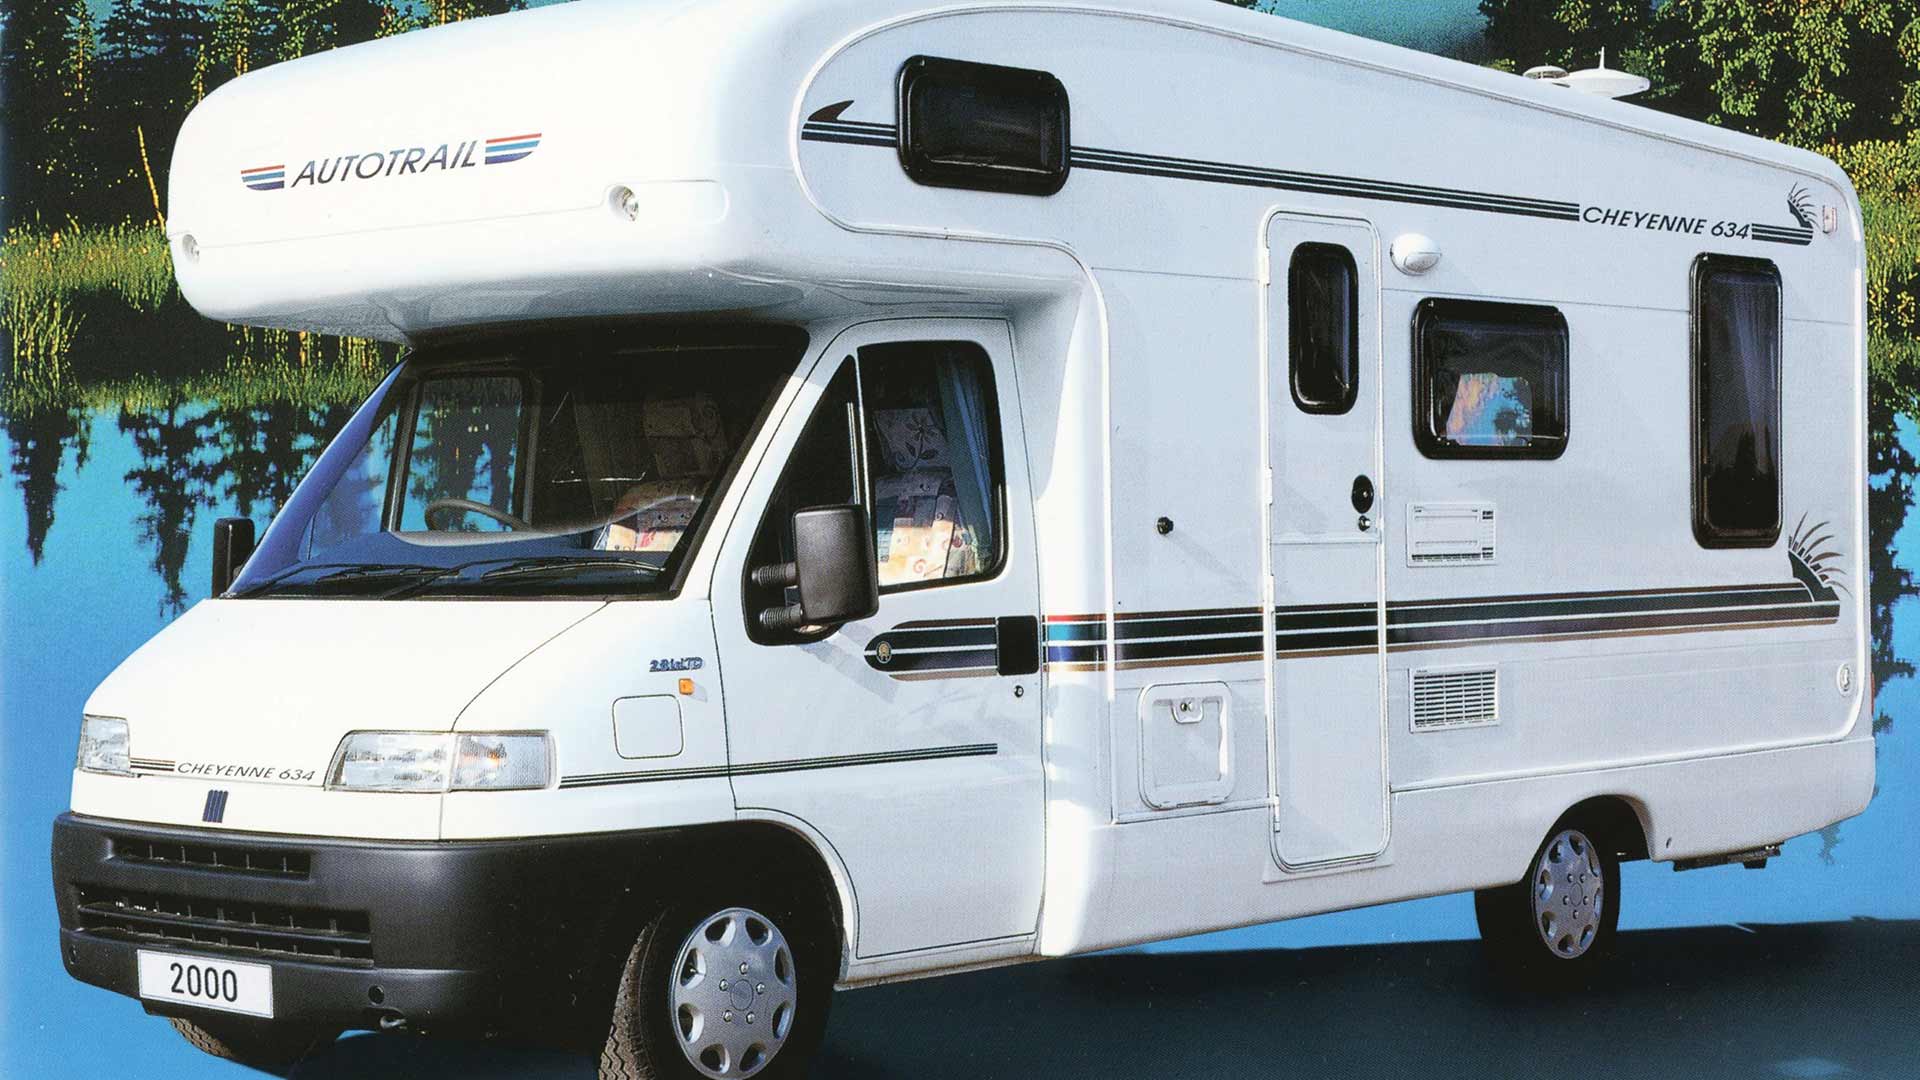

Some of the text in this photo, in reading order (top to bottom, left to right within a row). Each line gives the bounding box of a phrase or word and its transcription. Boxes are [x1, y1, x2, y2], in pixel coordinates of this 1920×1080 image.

[291, 140, 477, 188] AUTOTRAIL
[1583, 206, 1749, 239] CHEYENNE 634
[177, 762, 315, 781] CHEYENNE 634
[170, 963, 237, 1002] 2000
